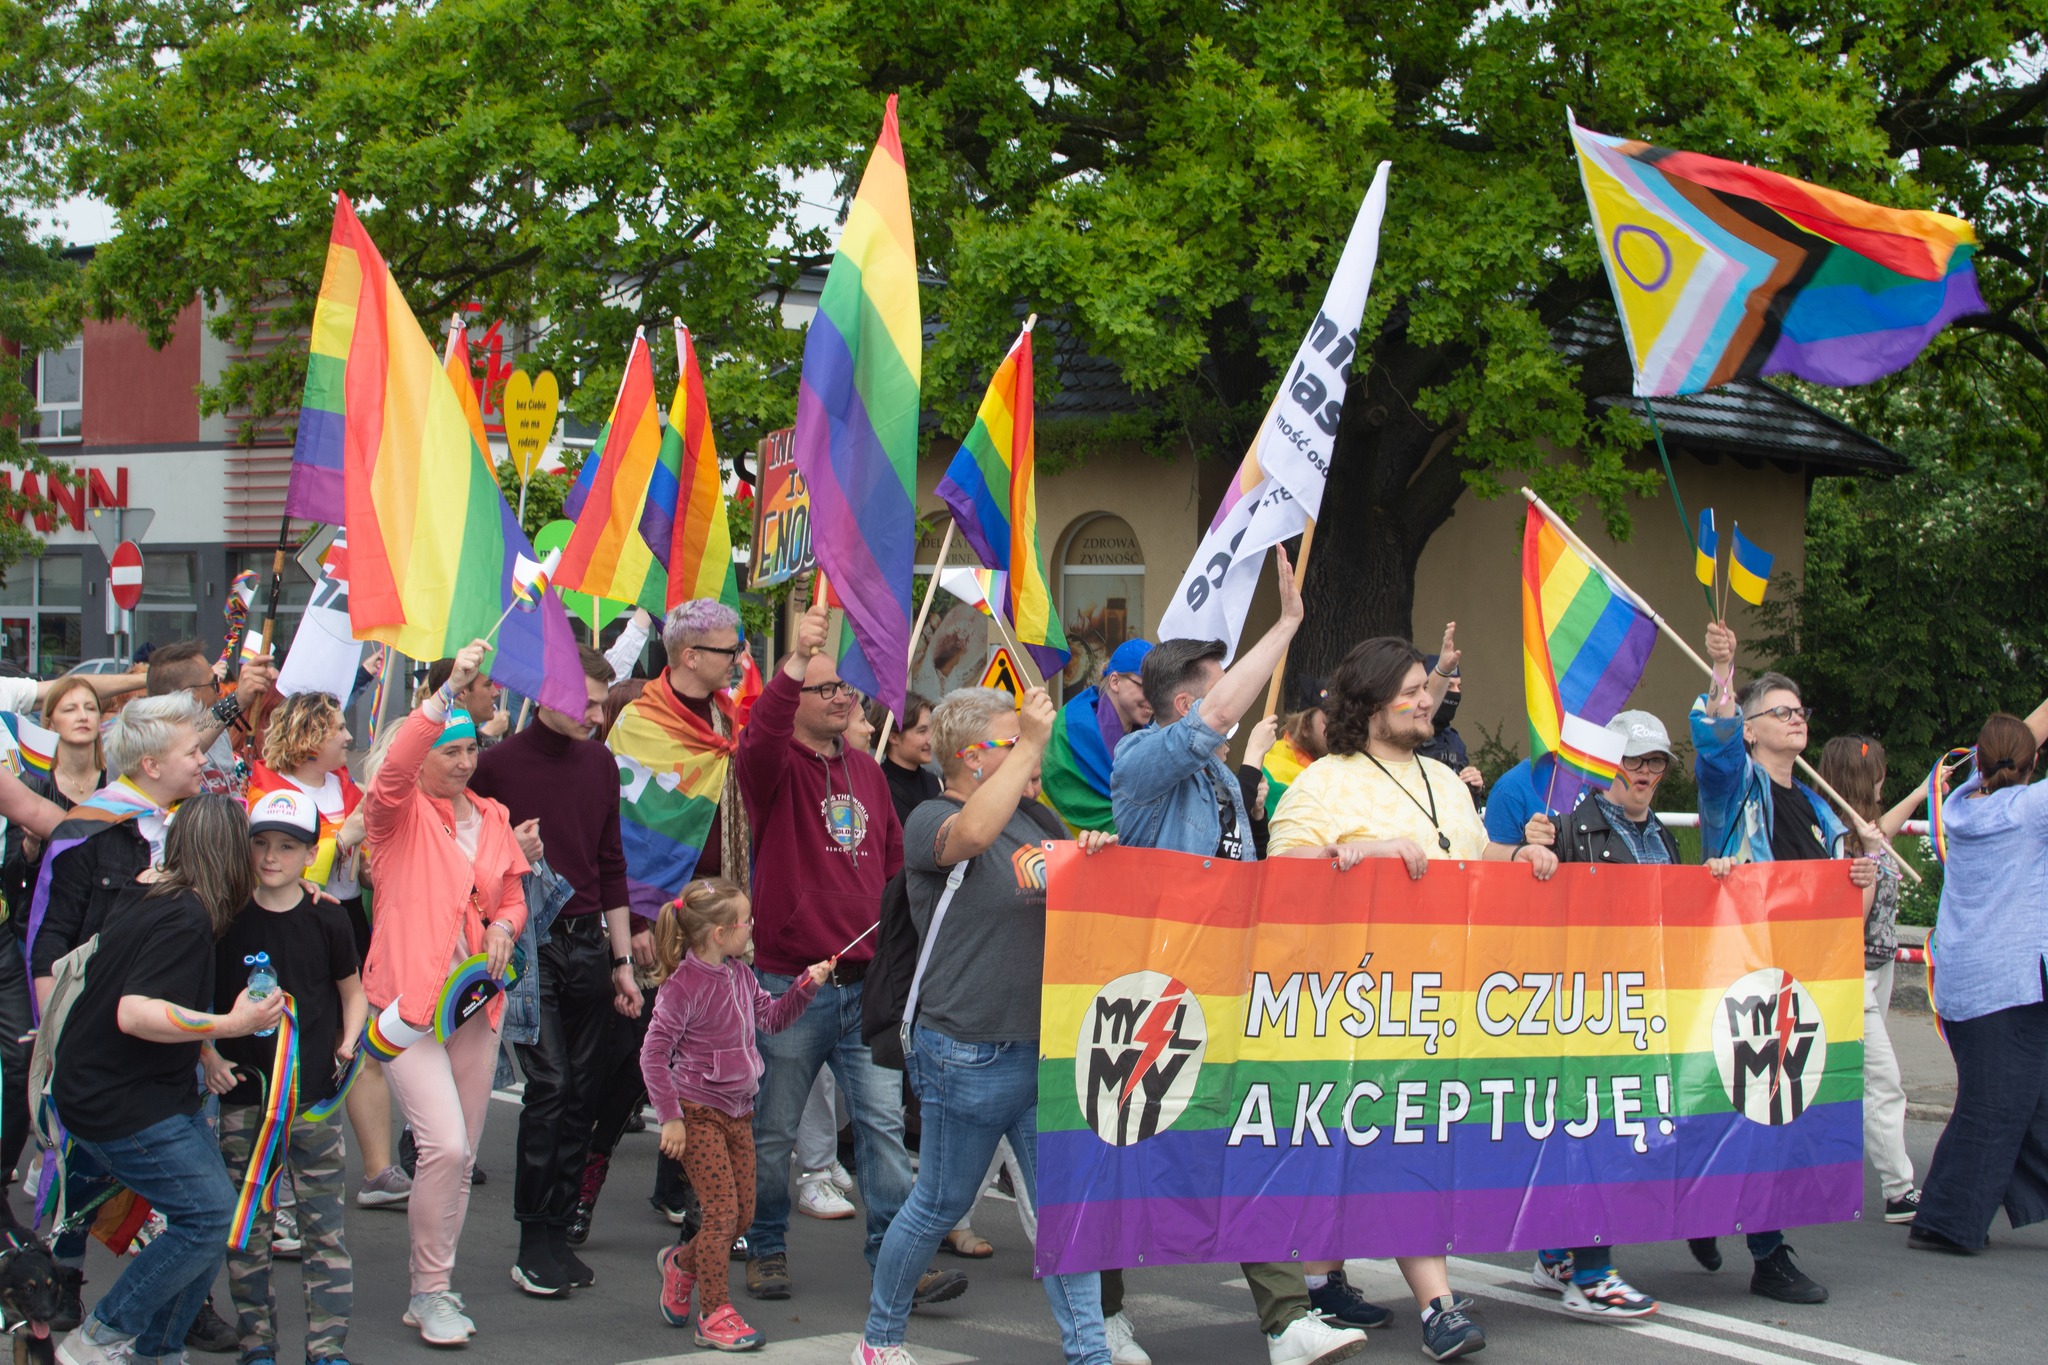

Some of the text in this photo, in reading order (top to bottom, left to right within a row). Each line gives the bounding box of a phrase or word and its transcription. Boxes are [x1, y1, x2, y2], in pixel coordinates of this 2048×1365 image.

[516, 400, 547, 410] bez Ciebie
[520, 418, 540, 429] nie ma
[518, 437, 540, 450] rodziny
[1082, 537, 1136, 549] ZDROWA
[1080, 551, 1139, 564] ŻYWNOŚĆ
[1244, 952, 1667, 1055] MYŚLĘ. CZUJĘ.
[1226, 1074, 1676, 1155] AKCEPTUJĘ!
